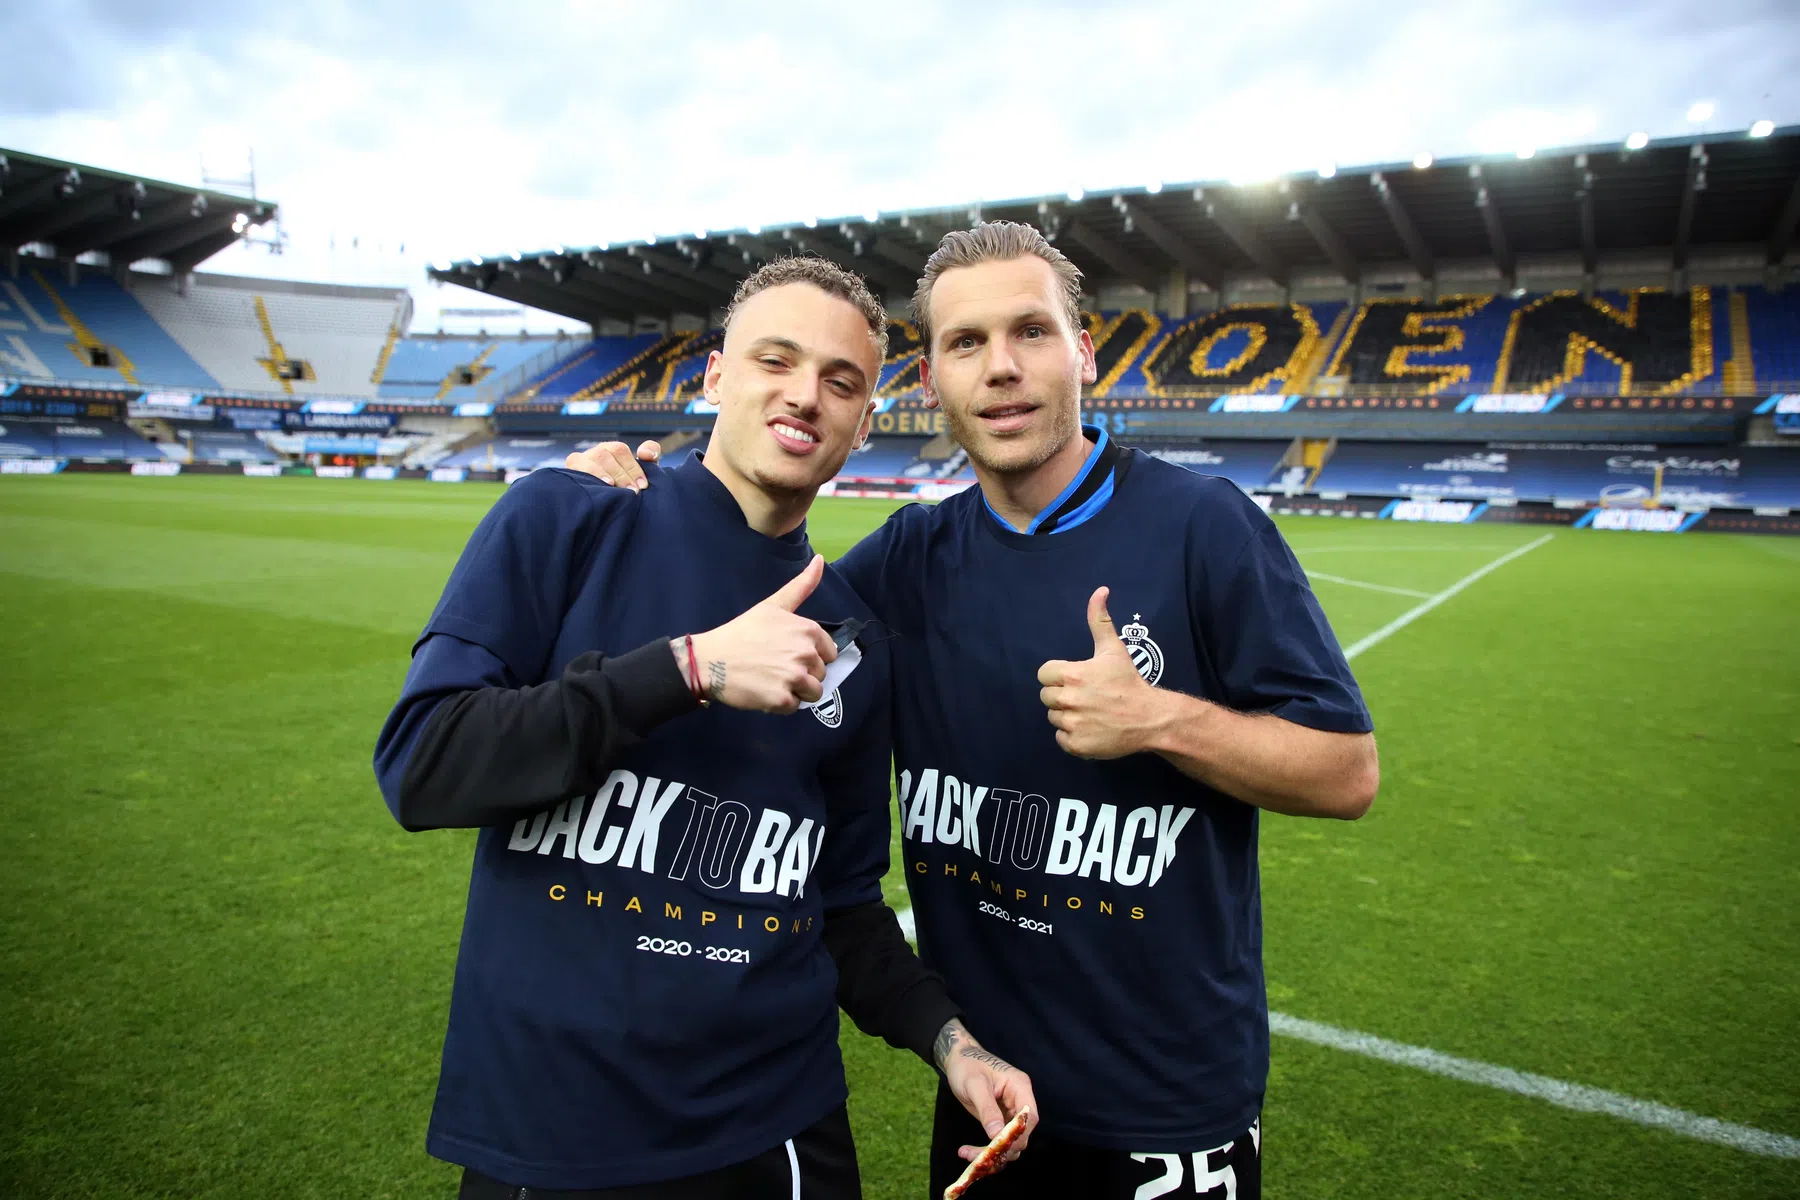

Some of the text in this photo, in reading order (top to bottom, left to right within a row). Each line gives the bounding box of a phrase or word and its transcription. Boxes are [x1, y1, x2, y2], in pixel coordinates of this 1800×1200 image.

[1305, 398, 1440, 409] CHAMPIONS
[1573, 398, 1735, 409] CHAMPIONS
[915, 861, 1145, 920] CHAMPIONS
[549, 884, 813, 934] CHAMPIONS
